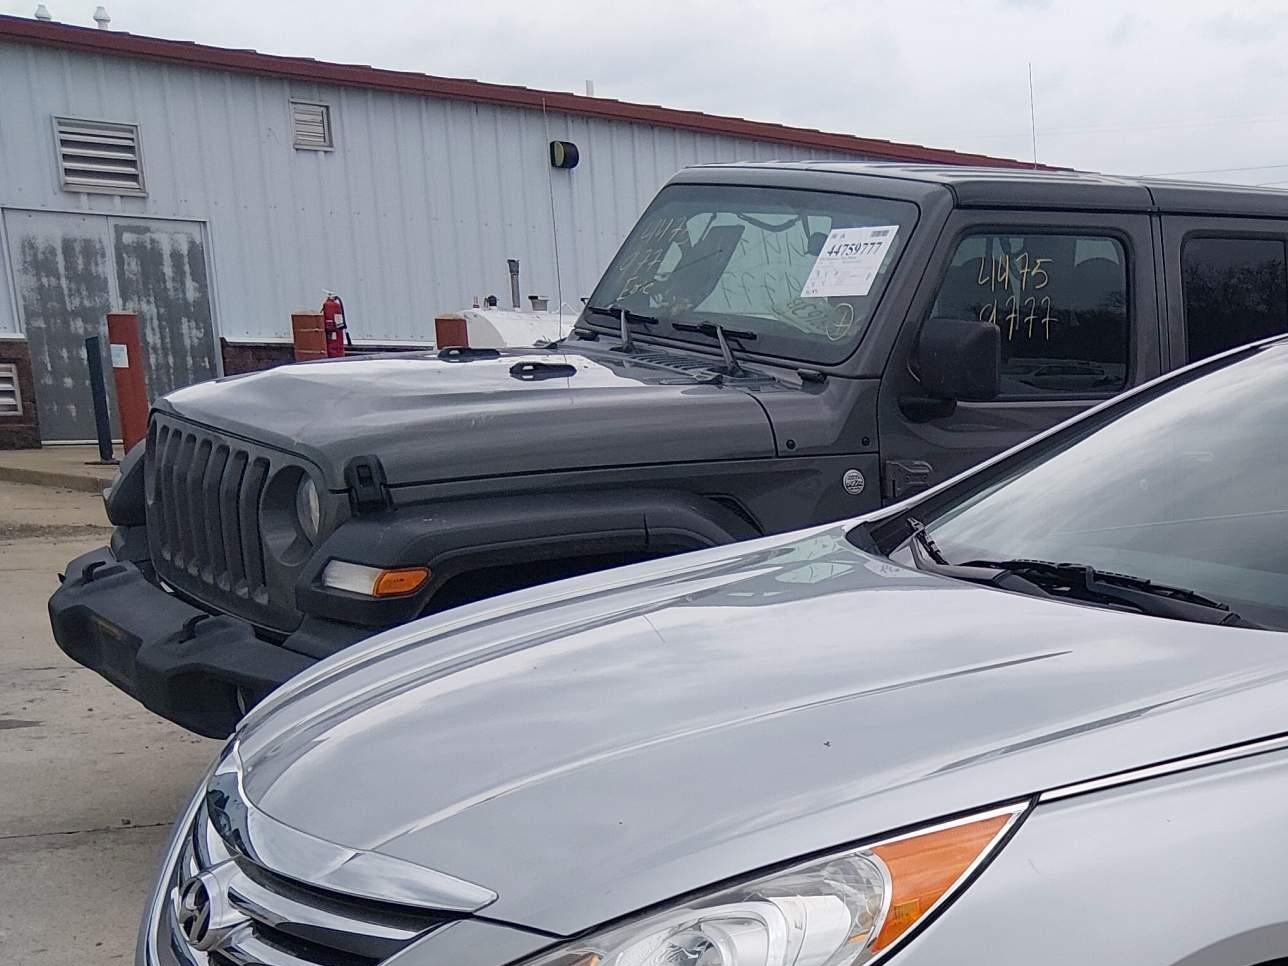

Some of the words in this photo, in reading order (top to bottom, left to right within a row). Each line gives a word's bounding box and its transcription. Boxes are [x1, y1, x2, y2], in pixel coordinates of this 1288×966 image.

[826, 241, 883, 257] 44759777
[978, 252, 1056, 292] 4475
[979, 295, 1060, 341] 9777
